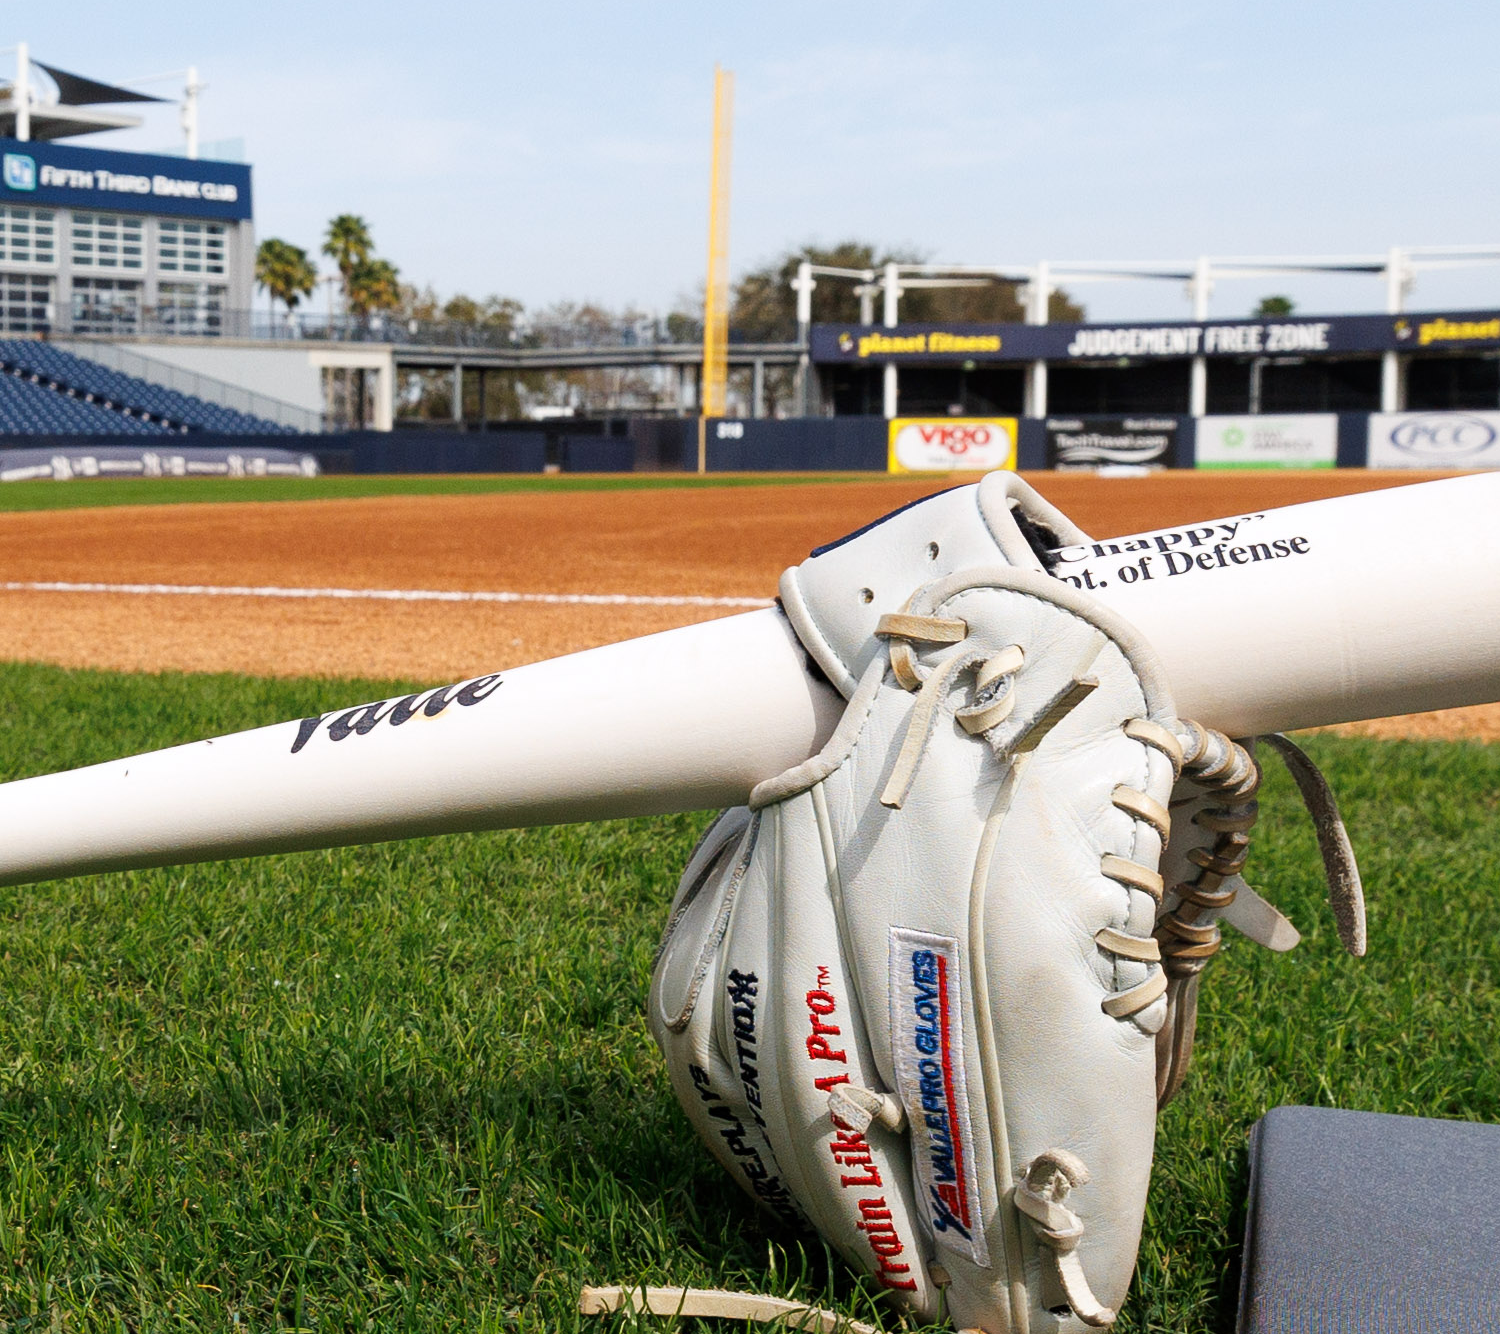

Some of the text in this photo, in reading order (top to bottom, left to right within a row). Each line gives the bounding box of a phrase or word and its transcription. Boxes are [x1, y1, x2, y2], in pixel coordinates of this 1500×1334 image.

[200, 182, 239, 203] CLUB
[858, 330, 1001, 358] planet fitness
[1068, 322, 1332, 356] JUDGEMENT FREE ZONE
[1117, 556, 1154, 584] of
[1161, 535, 1310, 578] Defense
[911, 949, 939, 1056] GLOVES
[855, 1195, 918, 1292] Train
